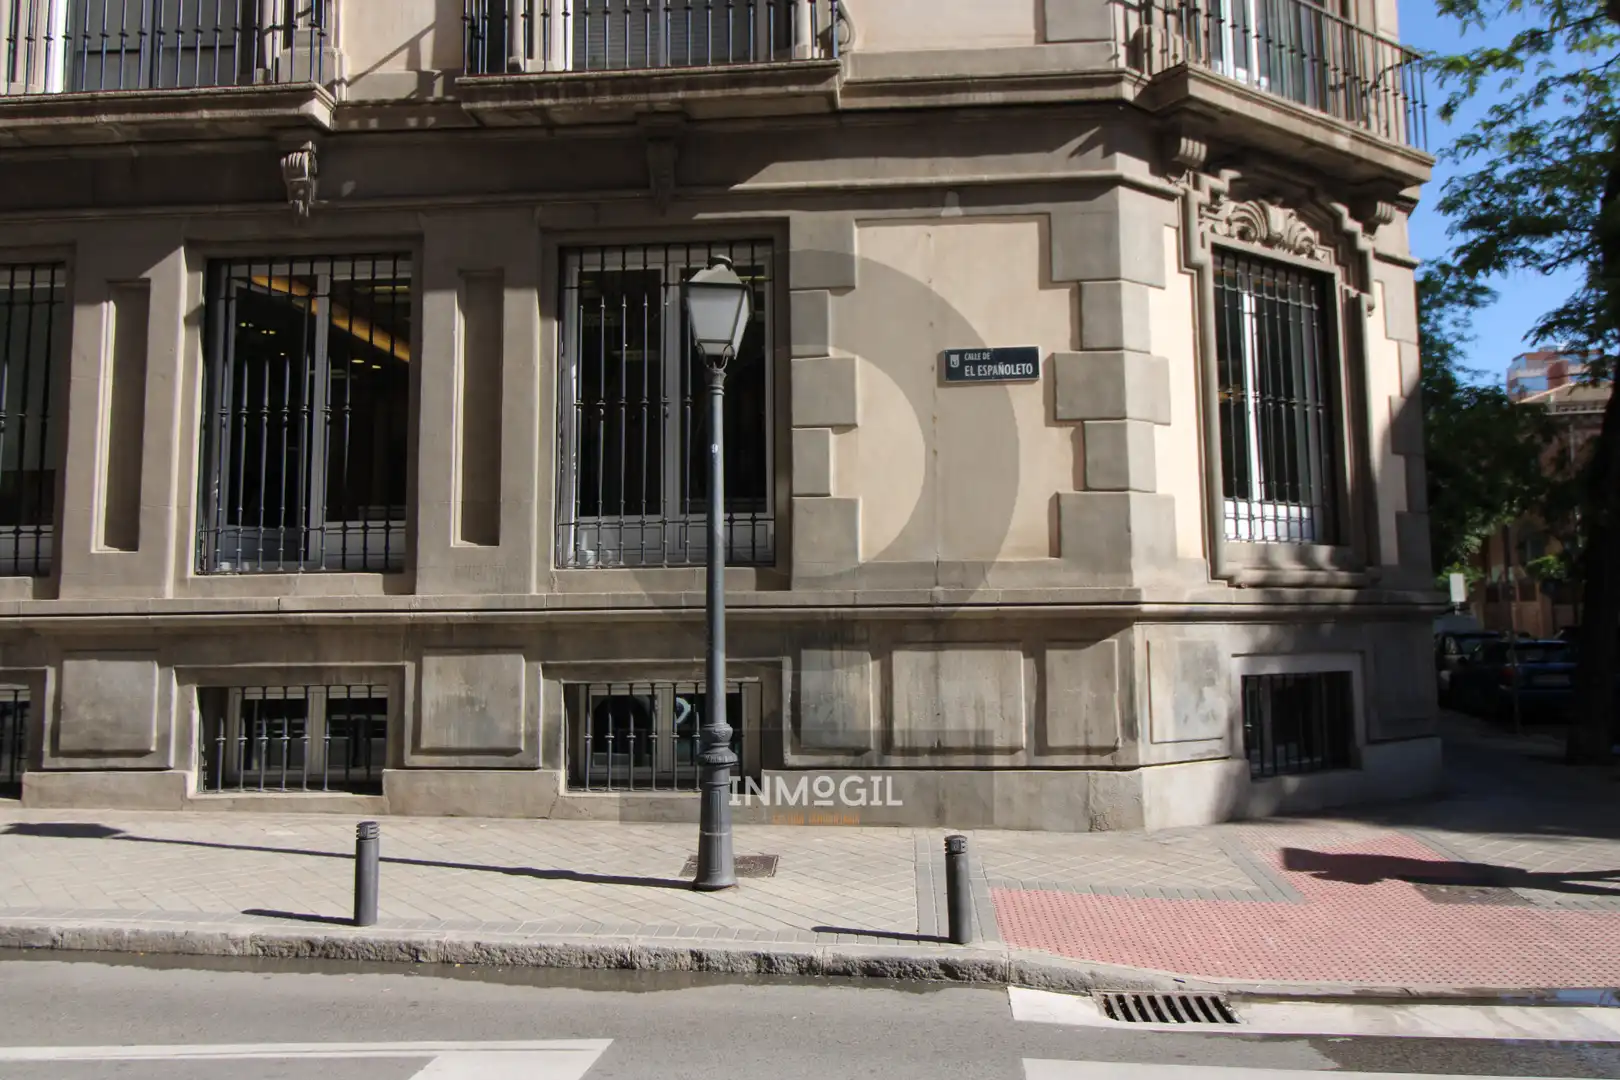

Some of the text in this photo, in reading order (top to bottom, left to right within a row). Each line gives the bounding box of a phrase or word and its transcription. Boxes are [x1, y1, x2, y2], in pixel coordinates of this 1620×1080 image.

[964, 352, 991, 361] CALLE DE
[964, 362, 1034, 377] EL ESPAÑOLETO
